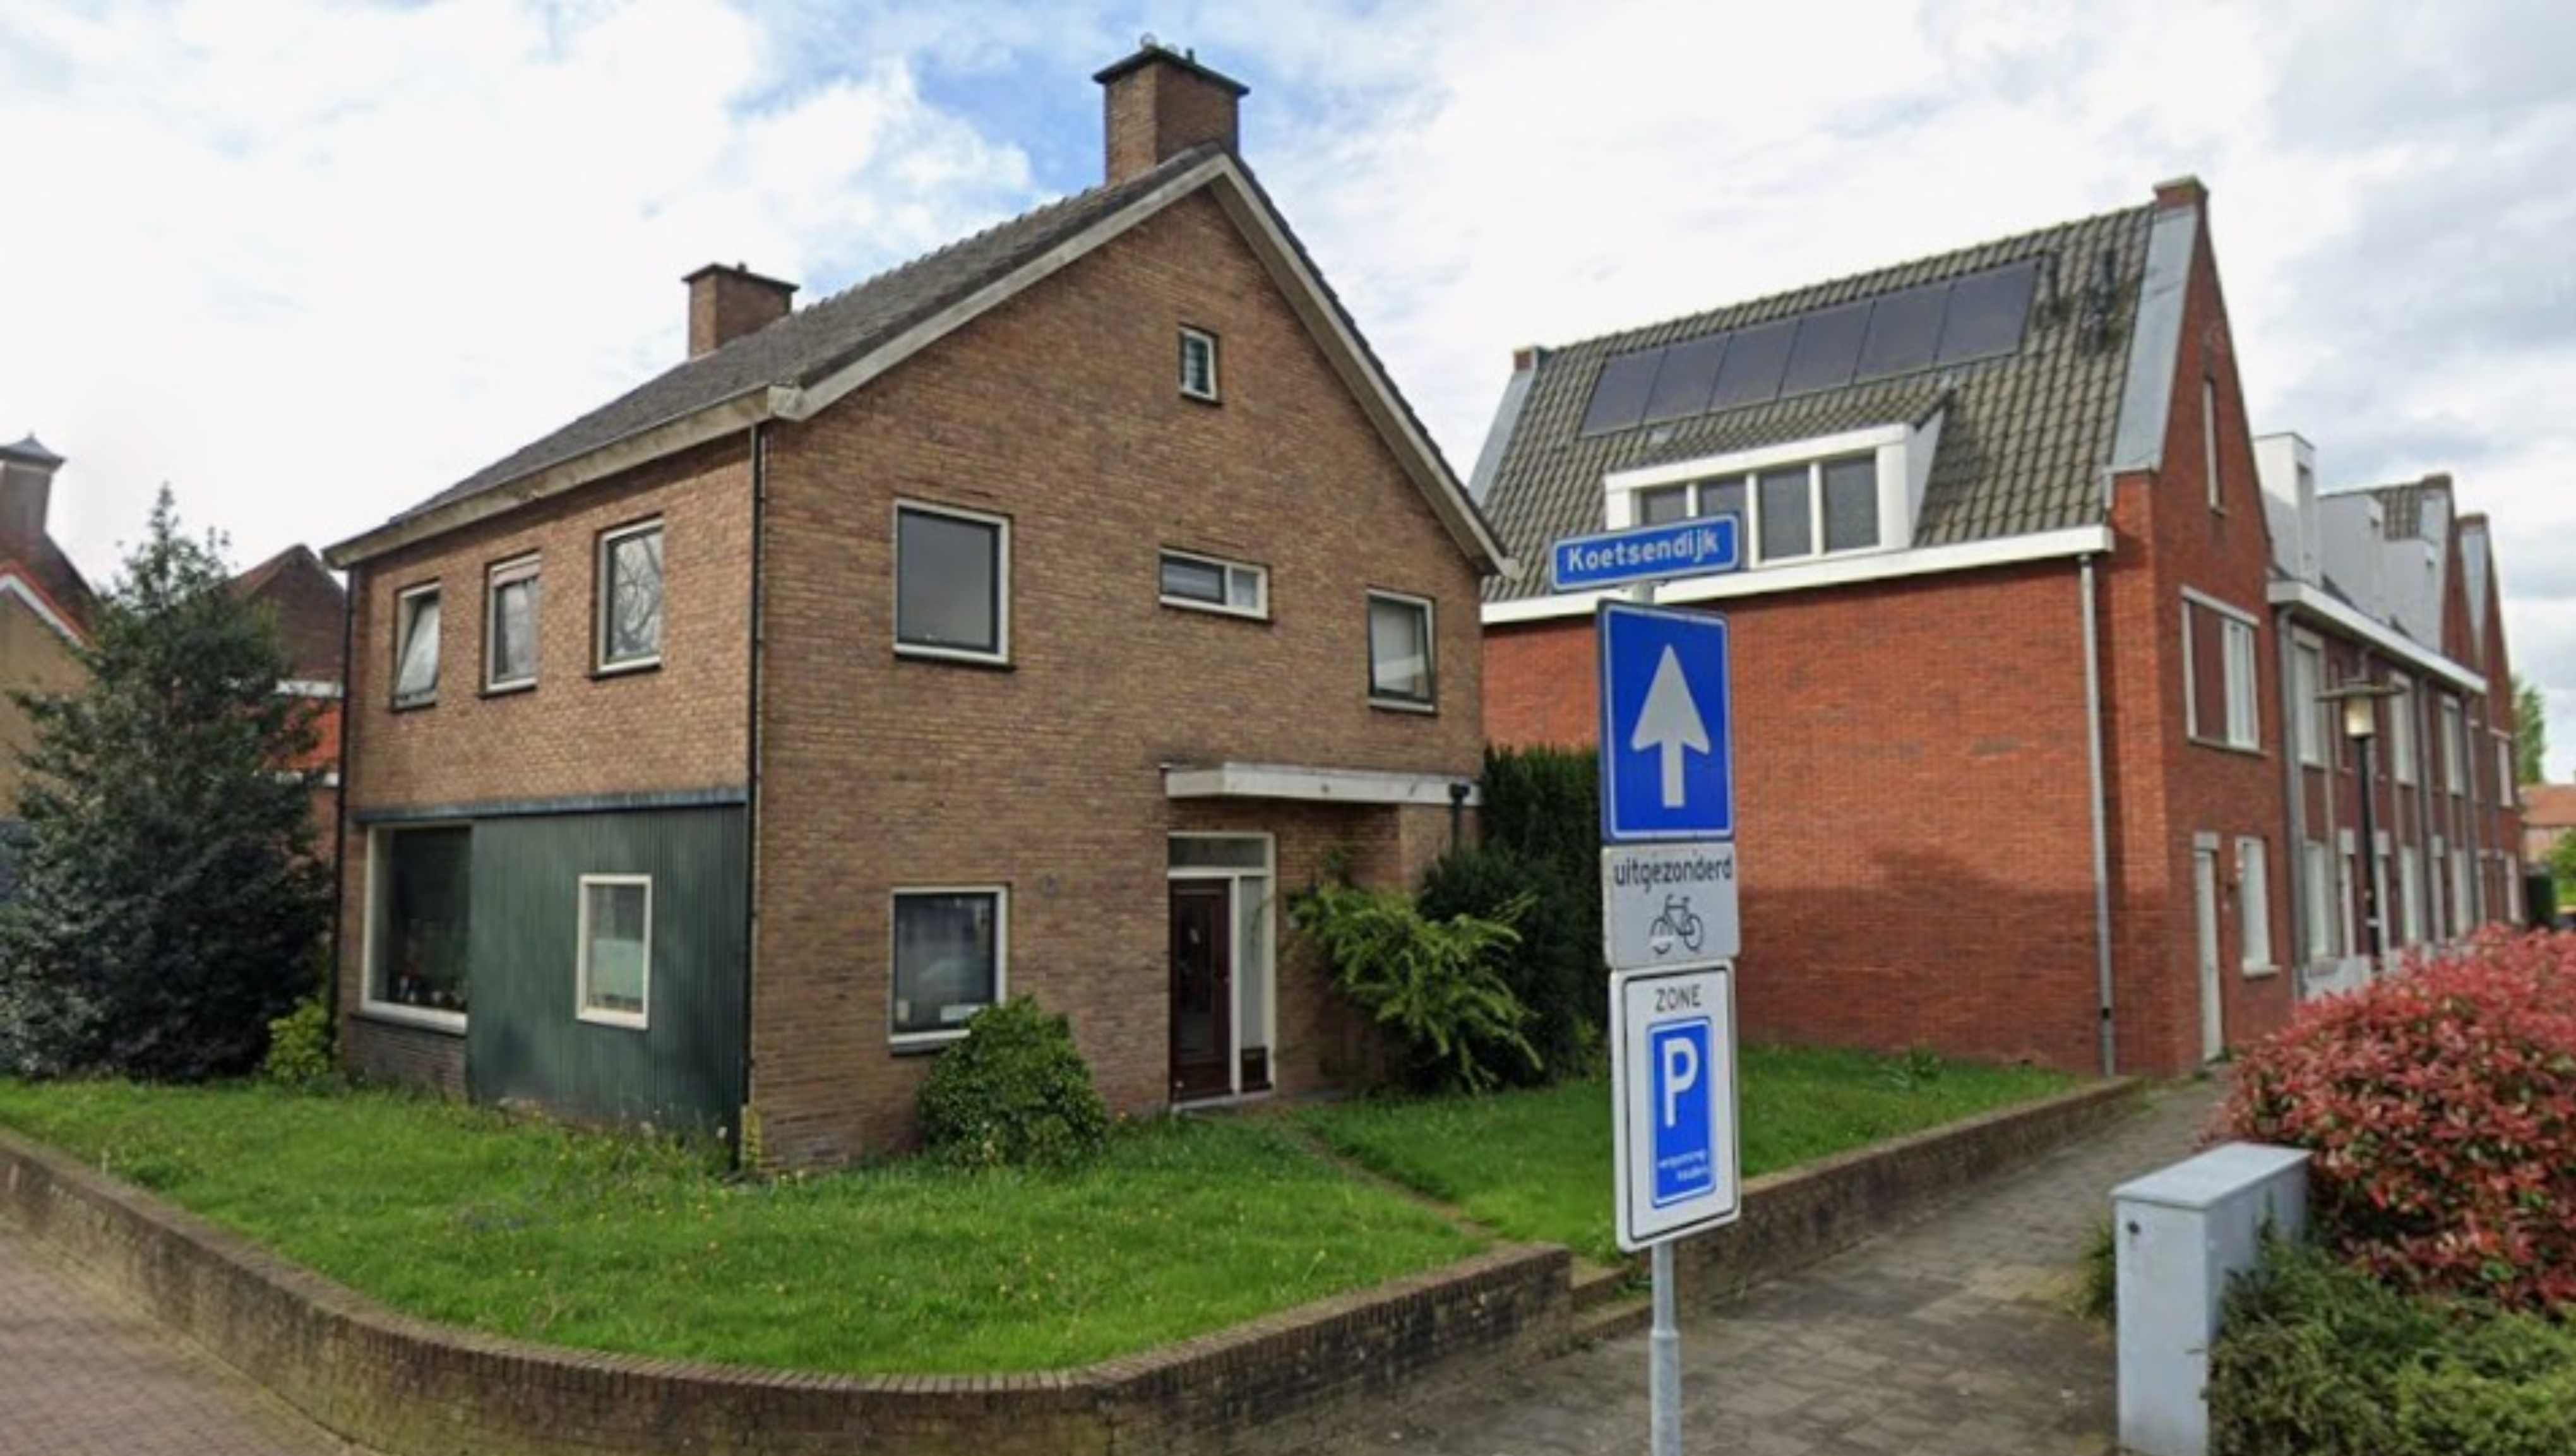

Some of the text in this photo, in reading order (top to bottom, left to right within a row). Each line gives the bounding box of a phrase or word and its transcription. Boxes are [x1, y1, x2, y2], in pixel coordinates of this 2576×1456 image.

[1566, 528, 1720, 573] Koetsendijk
[1614, 854, 1732, 894] uitgezonderd
[1655, 984, 1702, 1012] ZONE
[1664, 1037, 1698, 1128] P
